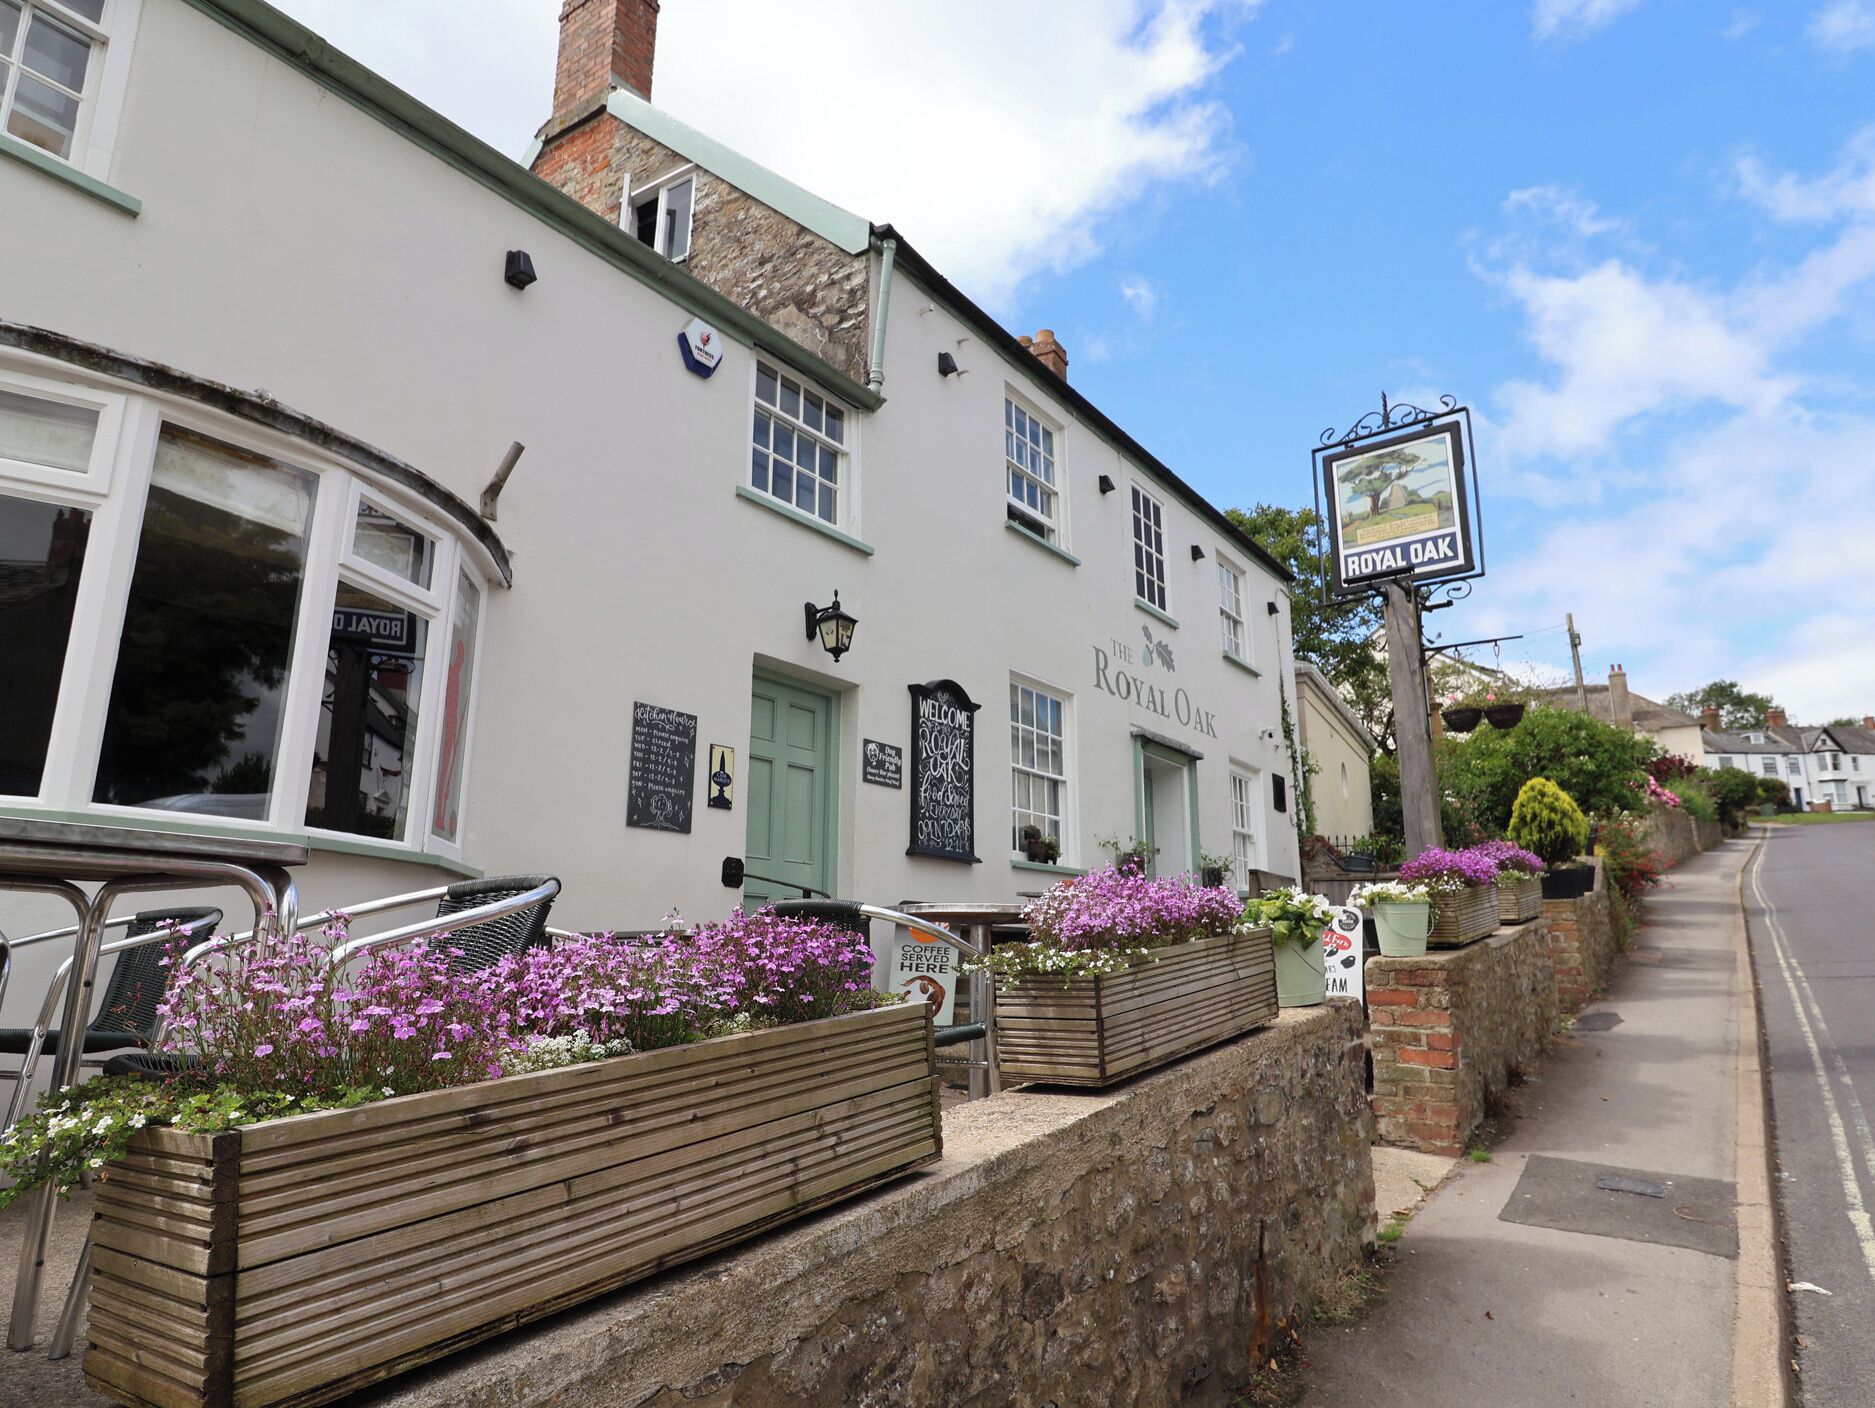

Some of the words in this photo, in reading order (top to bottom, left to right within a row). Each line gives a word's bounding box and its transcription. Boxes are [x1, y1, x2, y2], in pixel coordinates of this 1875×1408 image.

[1347, 547, 1406, 577] ROYAL
[1410, 536, 1454, 564] OAK
[1110, 638, 1134, 665] THE
[1092, 646, 1170, 719] ROYAL
[1174, 688, 1218, 740] OAK
[919, 696, 970, 731] WELCOME
[885, 746, 896, 758] Dog
[884, 761, 896, 772] Pub
[930, 755, 963, 785] OAK
[918, 819, 942, 841] OPEN
[901, 944, 951, 956] COFFEE
[901, 952, 950, 963] SERVED
[900, 961, 949, 974] HERE
[1326, 977, 1348, 993] EAM
